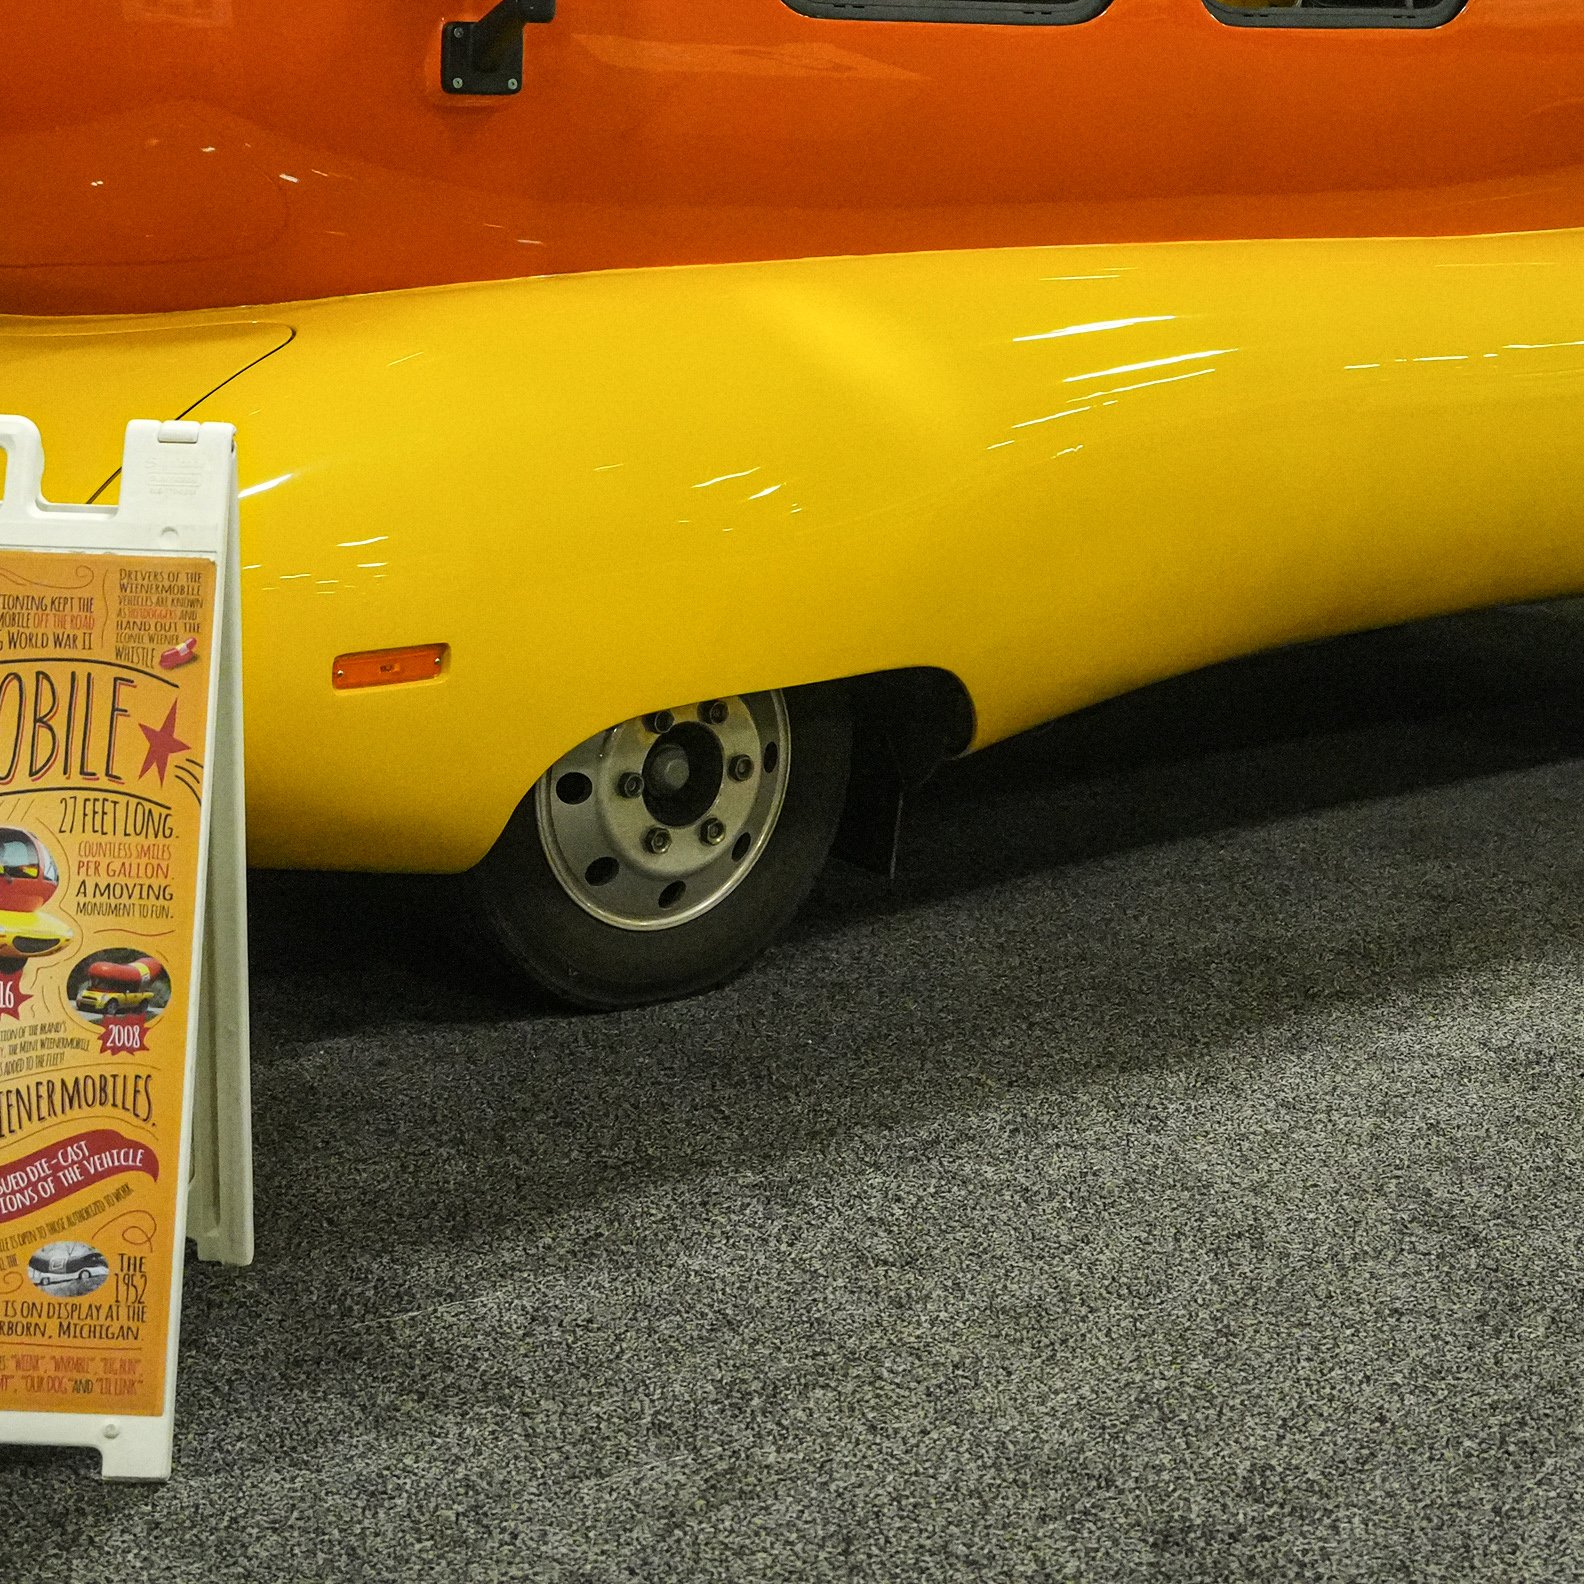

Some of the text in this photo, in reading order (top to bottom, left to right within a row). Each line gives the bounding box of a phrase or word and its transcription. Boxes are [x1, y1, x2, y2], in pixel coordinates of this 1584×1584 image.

[119, 568, 164, 583] DRIVERS
[50, 595, 74, 612] KEPT
[77, 596, 94, 613] THE
[117, 620, 200, 633] HAND OUT THE
[7, 629, 49, 650] WORLD
[53, 631, 78, 650] WAR
[116, 646, 155, 668] WHISTLE
[58, 796, 180, 839] 27 FEET LONG.
[78, 840, 171, 860] COUNTLESS SMILES
[77, 861, 174, 880] PER GALLON.
[75, 880, 174, 901] A MOVING
[76, 901, 174, 919] MONUMENT TO FUN.
[106, 1023, 141, 1048] 2008
[27, 1140, 90, 1184] DIE-CAST
[37, 1179, 56, 1204] OF
[58, 1164, 86, 1194] THE
[85, 1147, 145, 1179] VEHICLE
[119, 1252, 147, 1274] THE
[114, 1273, 148, 1304] 1952
[2, 1298, 17, 1318] IS
[21, 1298, 44, 1319] ON
[46, 1299, 102, 1321] DISPLAY
[105, 1301, 123, 1321] AT
[125, 1304, 148, 1323] THE
